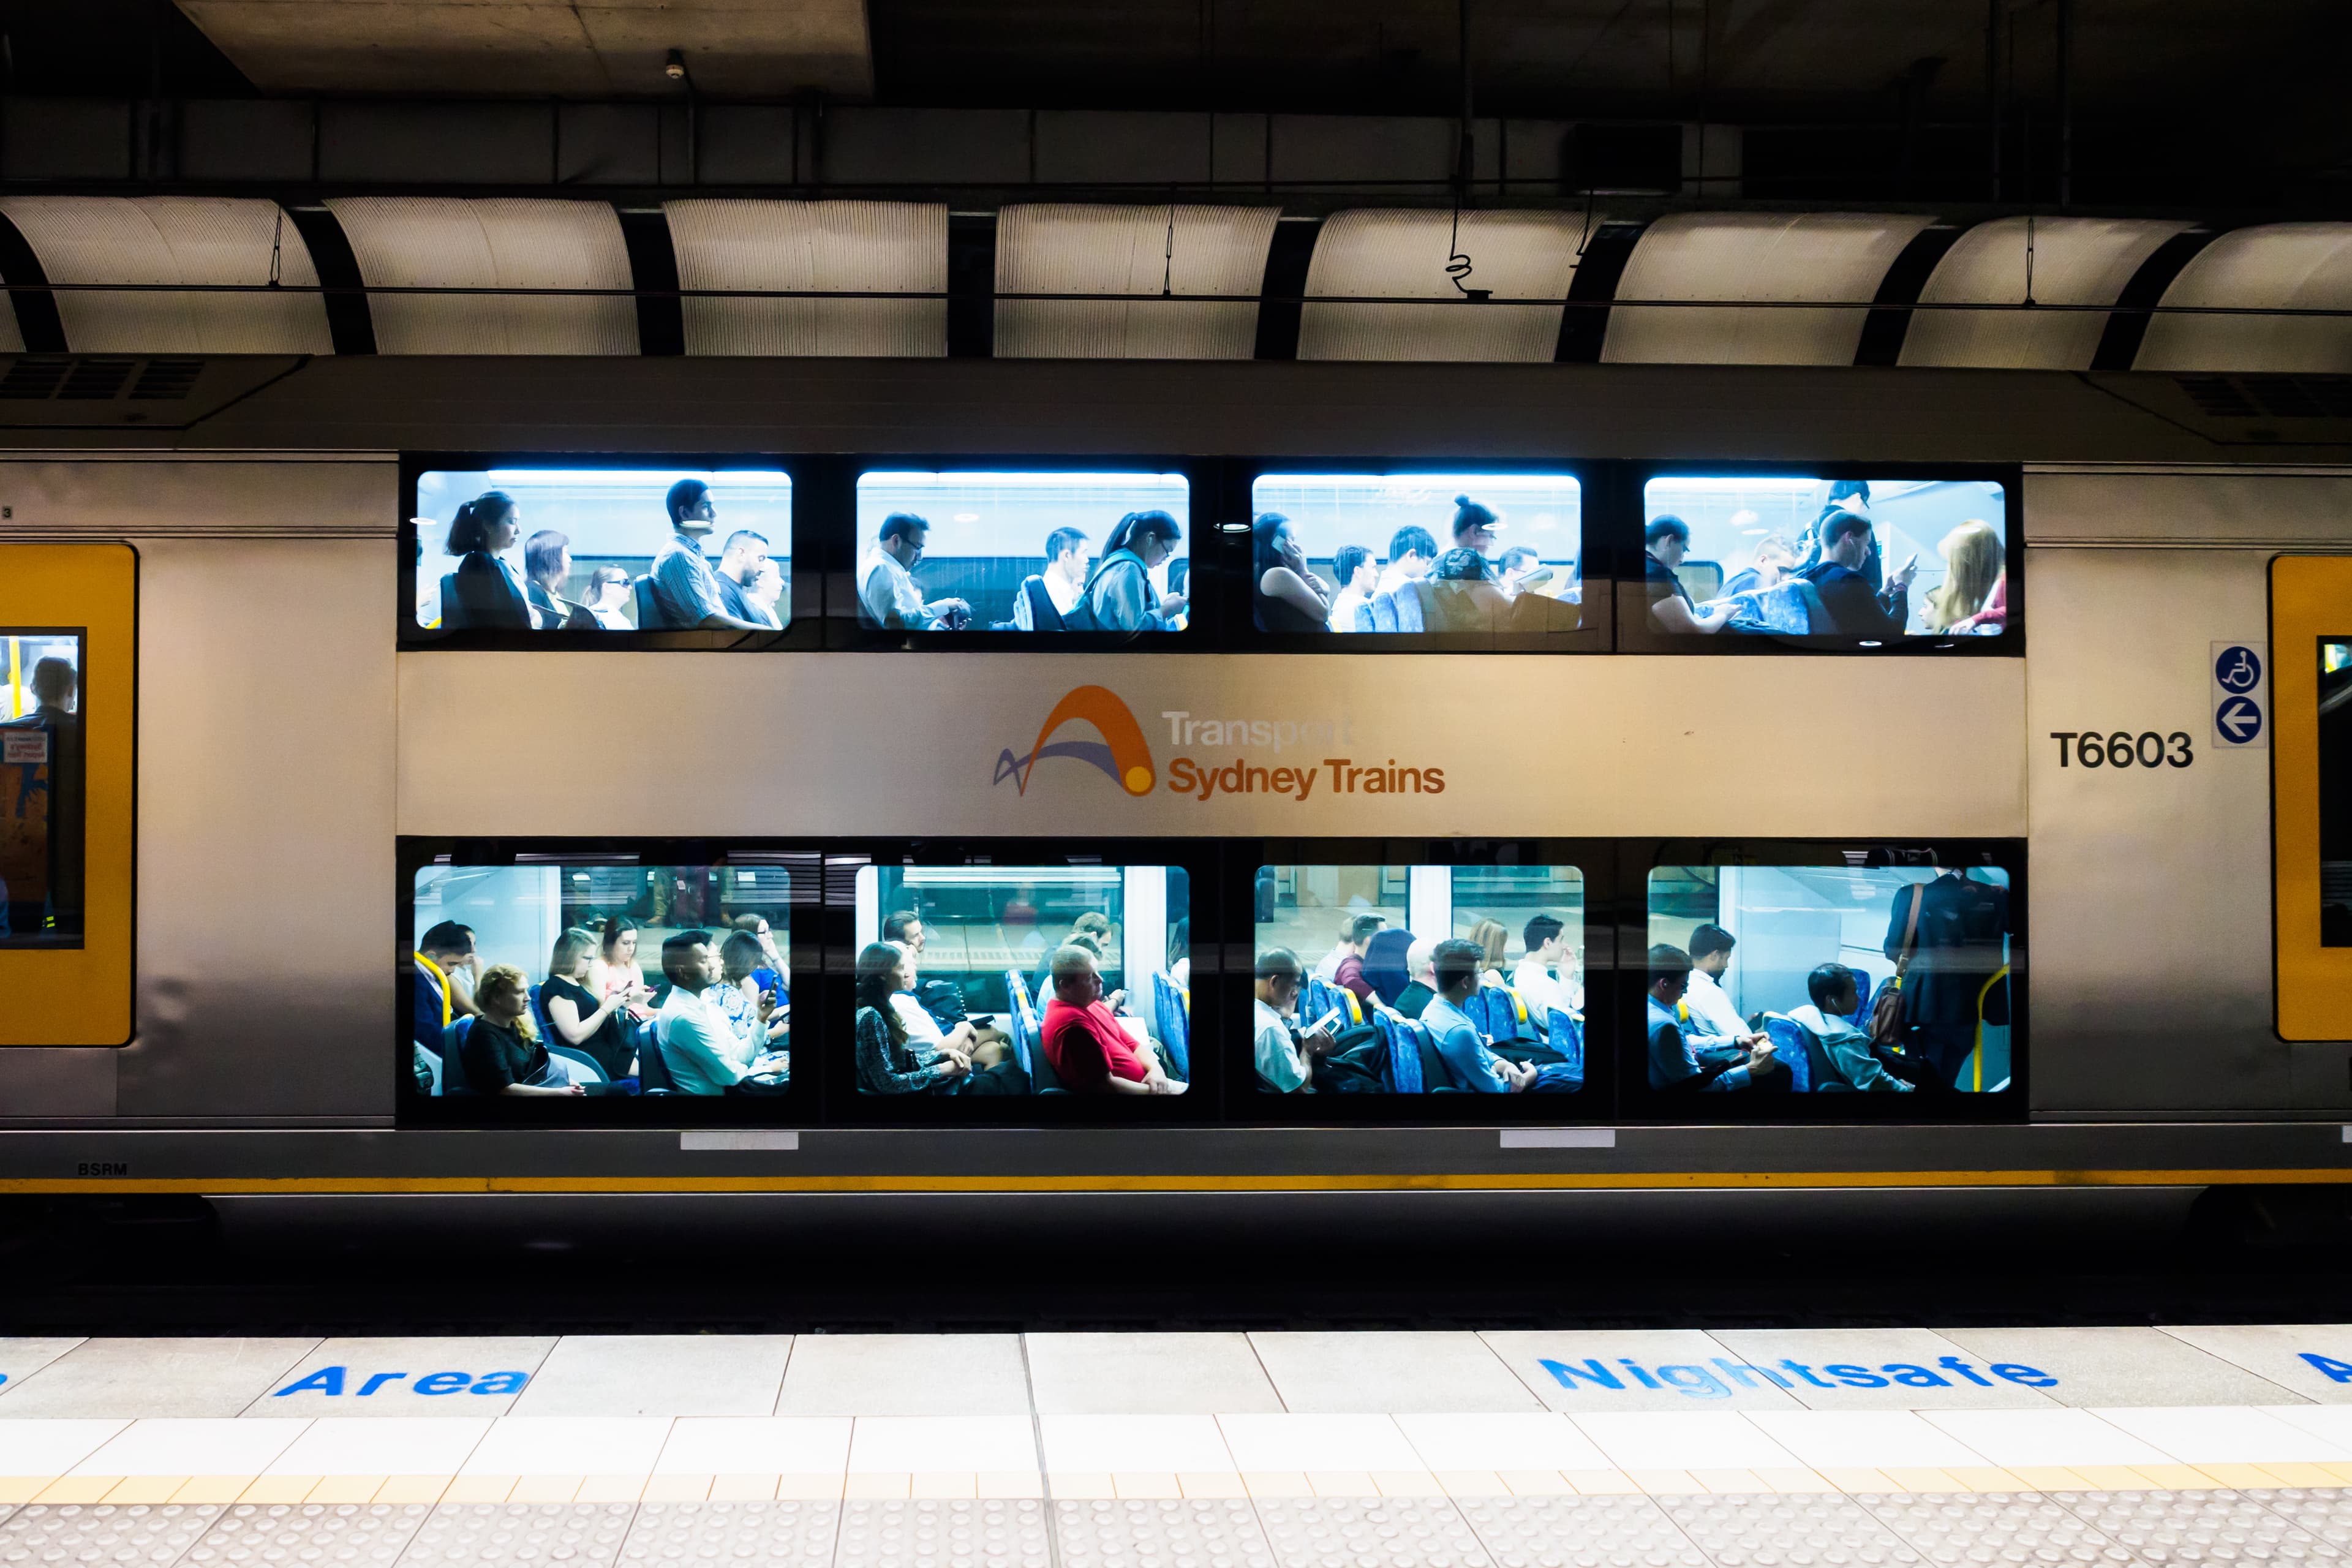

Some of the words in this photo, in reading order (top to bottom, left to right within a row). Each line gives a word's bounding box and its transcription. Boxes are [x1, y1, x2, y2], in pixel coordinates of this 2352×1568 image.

[2050, 731, 2194, 769] T6603
[1168, 757, 1317, 801] Sydney
[1323, 758, 1446, 794] Trains
[78, 1163, 127, 1175] BSRM
[273, 1366, 530, 1396] Area
[1537, 1355, 2059, 1399] Nightsafe
